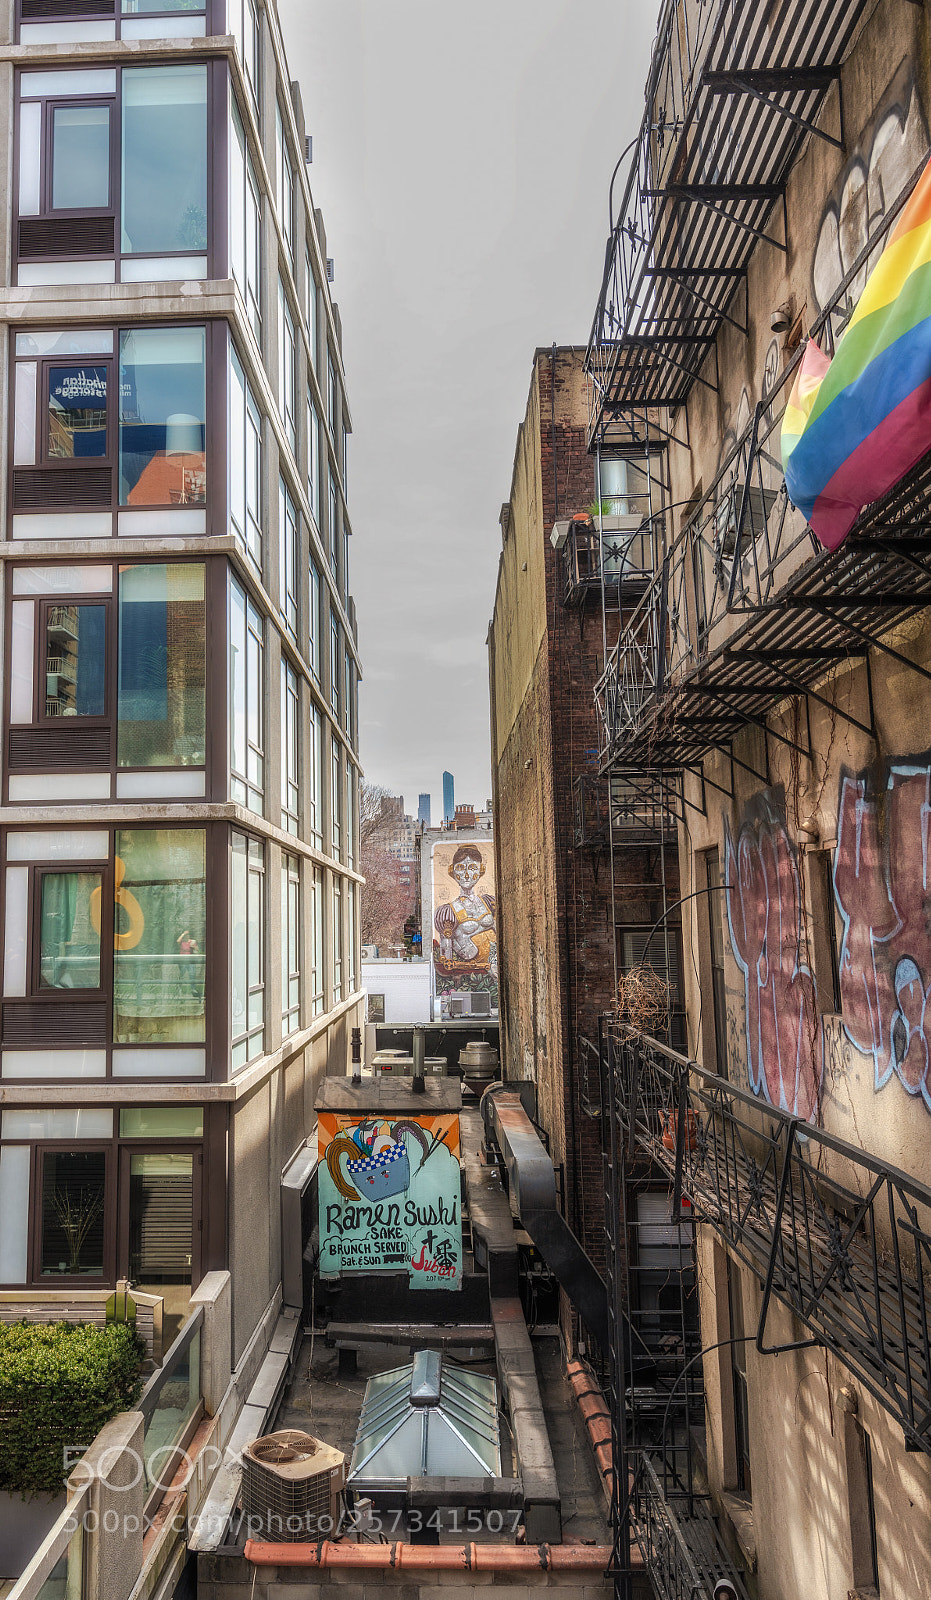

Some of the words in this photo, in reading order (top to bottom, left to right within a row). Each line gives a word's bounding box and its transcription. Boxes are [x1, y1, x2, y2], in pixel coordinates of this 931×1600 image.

[326, 1203, 400, 1234] Ramen
[403, 1195, 459, 1227] Sushi
[370, 1227, 404, 1240] SAKE
[329, 1243, 371, 1256] BRUNCH
[374, 1242, 407, 1253] SERVED
[411, 1245, 456, 1278] Juban
